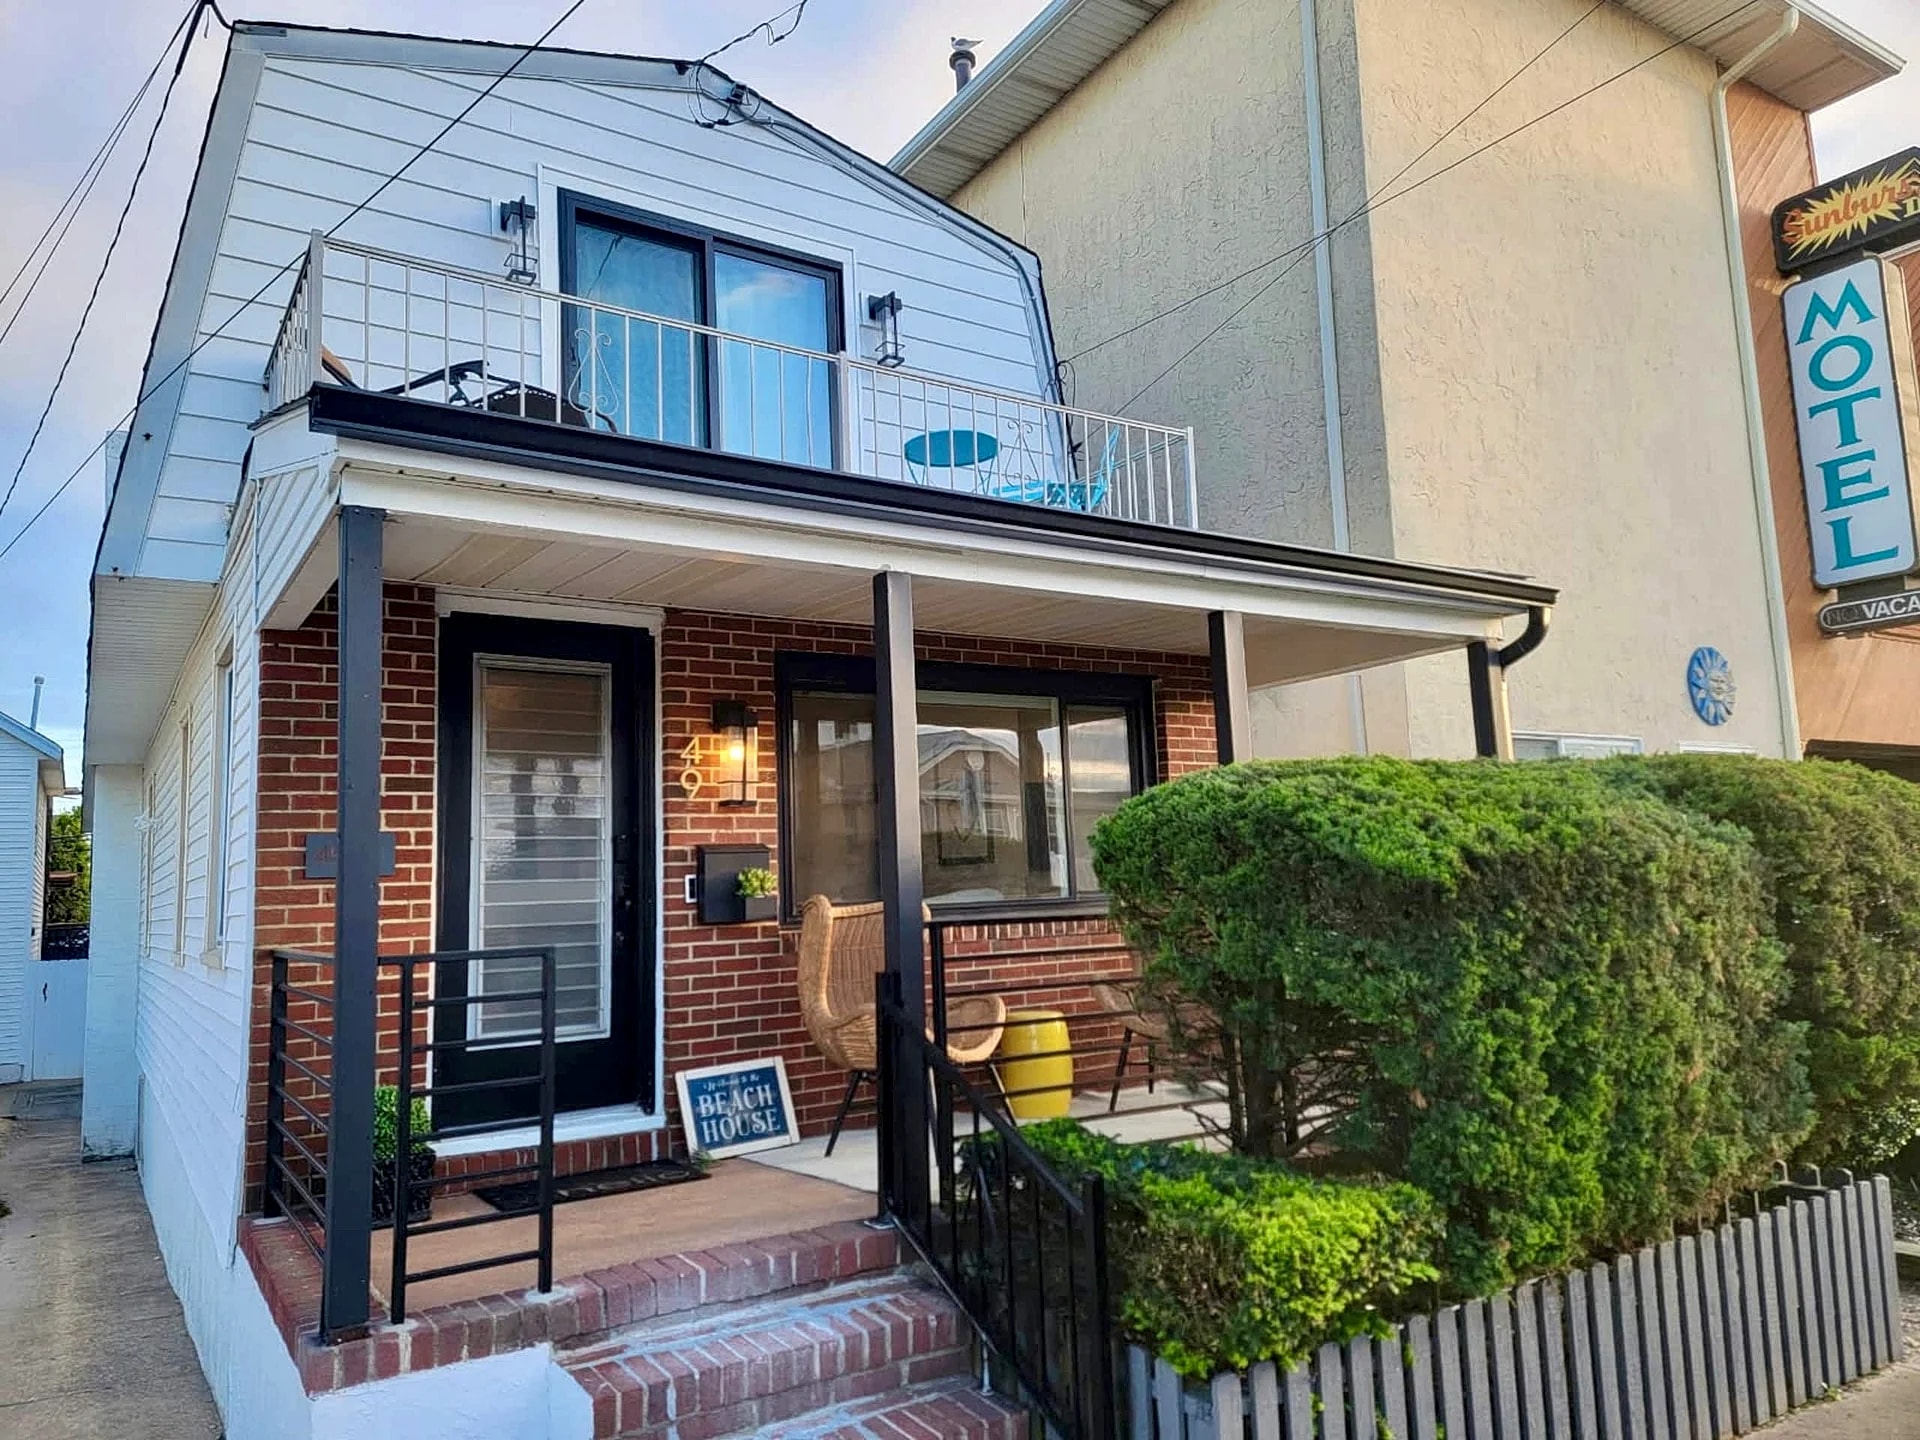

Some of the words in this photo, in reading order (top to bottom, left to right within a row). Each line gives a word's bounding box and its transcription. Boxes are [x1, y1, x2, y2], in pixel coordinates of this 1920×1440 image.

[1795, 278, 1899, 571] MOTEL
[680, 736, 703, 800] 49
[697, 1083, 774, 1118] BEACH
[701, 1109, 780, 1143] HOUSE
